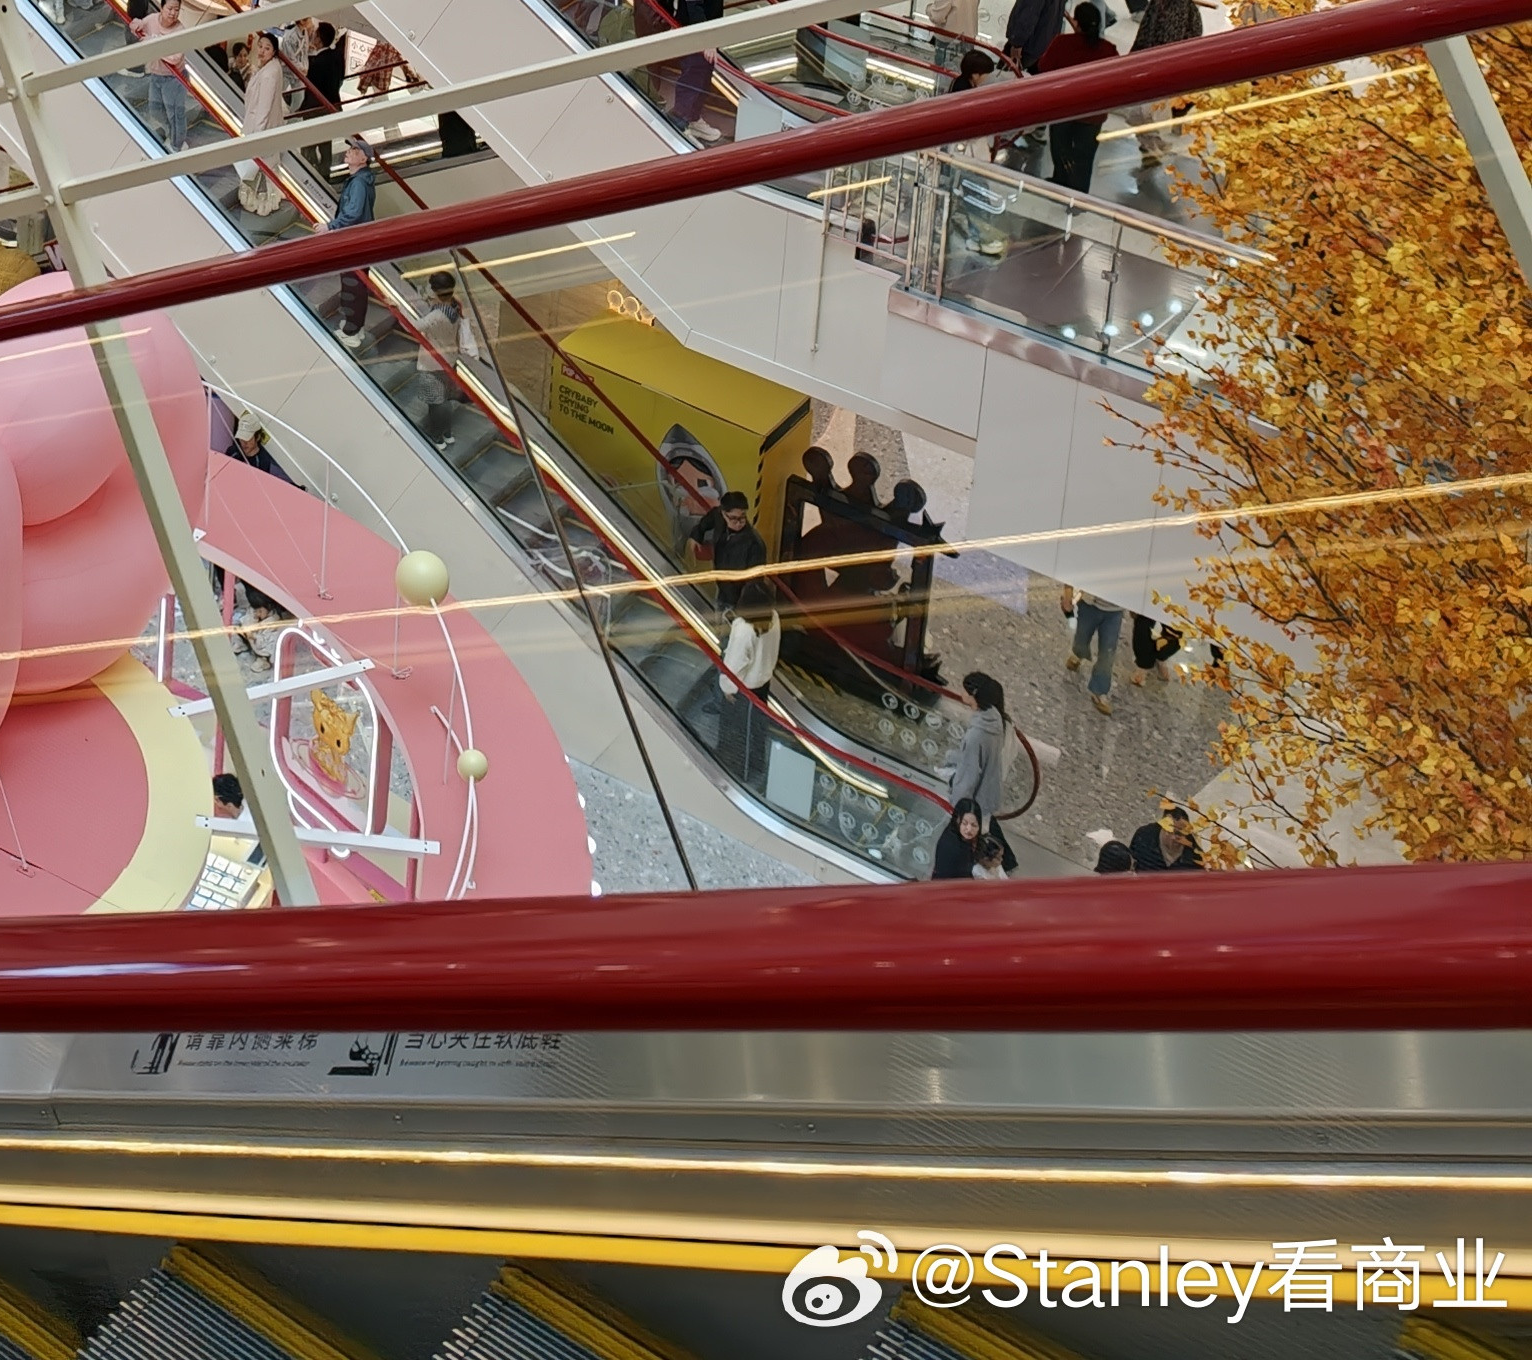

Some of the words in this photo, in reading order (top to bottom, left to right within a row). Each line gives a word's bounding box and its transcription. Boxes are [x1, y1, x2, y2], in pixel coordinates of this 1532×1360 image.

[559, 385, 598, 408] CRYBABY
[559, 395, 589, 414] CRYING
[559, 404, 570, 415] TO
[571, 408, 587, 423] THE
[588, 416, 614, 435] MOON
